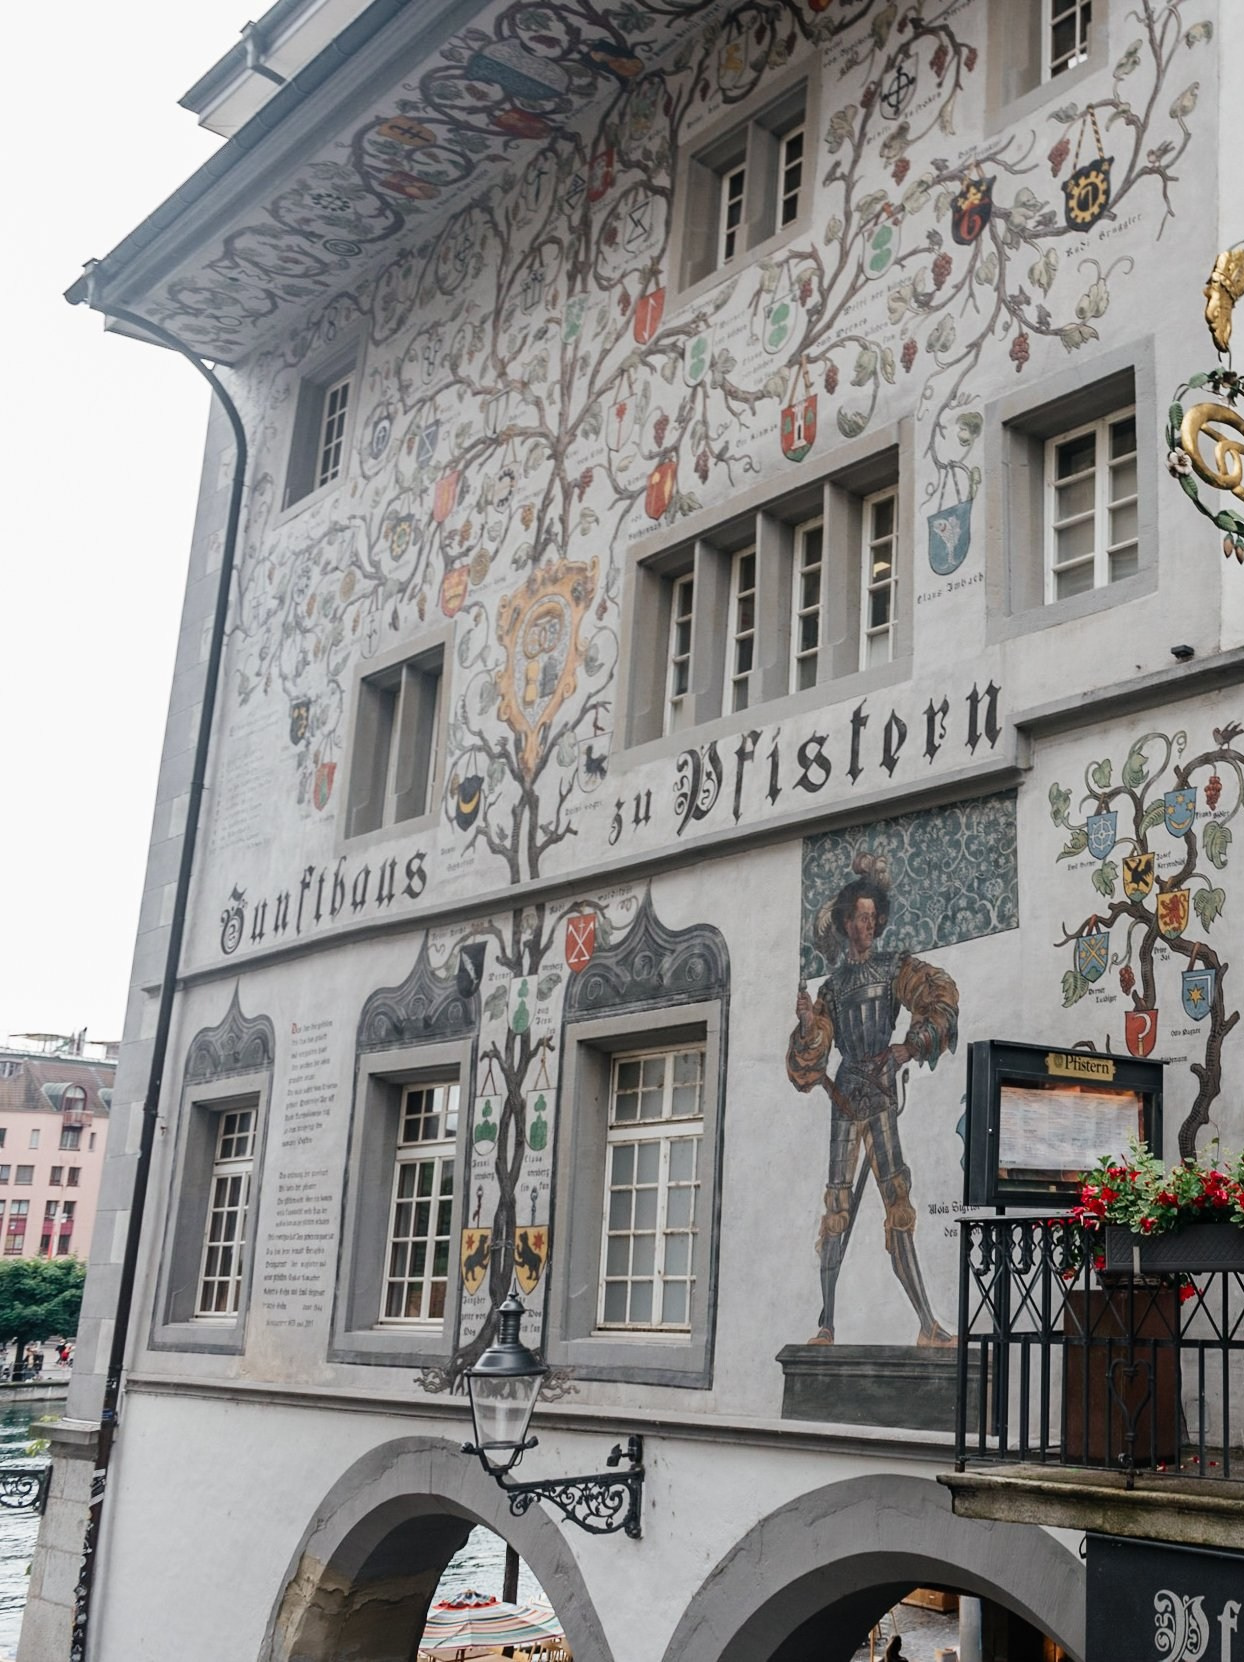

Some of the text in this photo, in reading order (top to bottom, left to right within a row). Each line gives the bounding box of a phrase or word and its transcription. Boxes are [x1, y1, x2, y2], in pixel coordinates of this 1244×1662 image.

[608, 788, 653, 846] zu
[674, 679, 1003, 837] Pfistern
[1064, 1053, 1110, 1075] Pfistern
[928, 1202, 949, 1215] Alois
